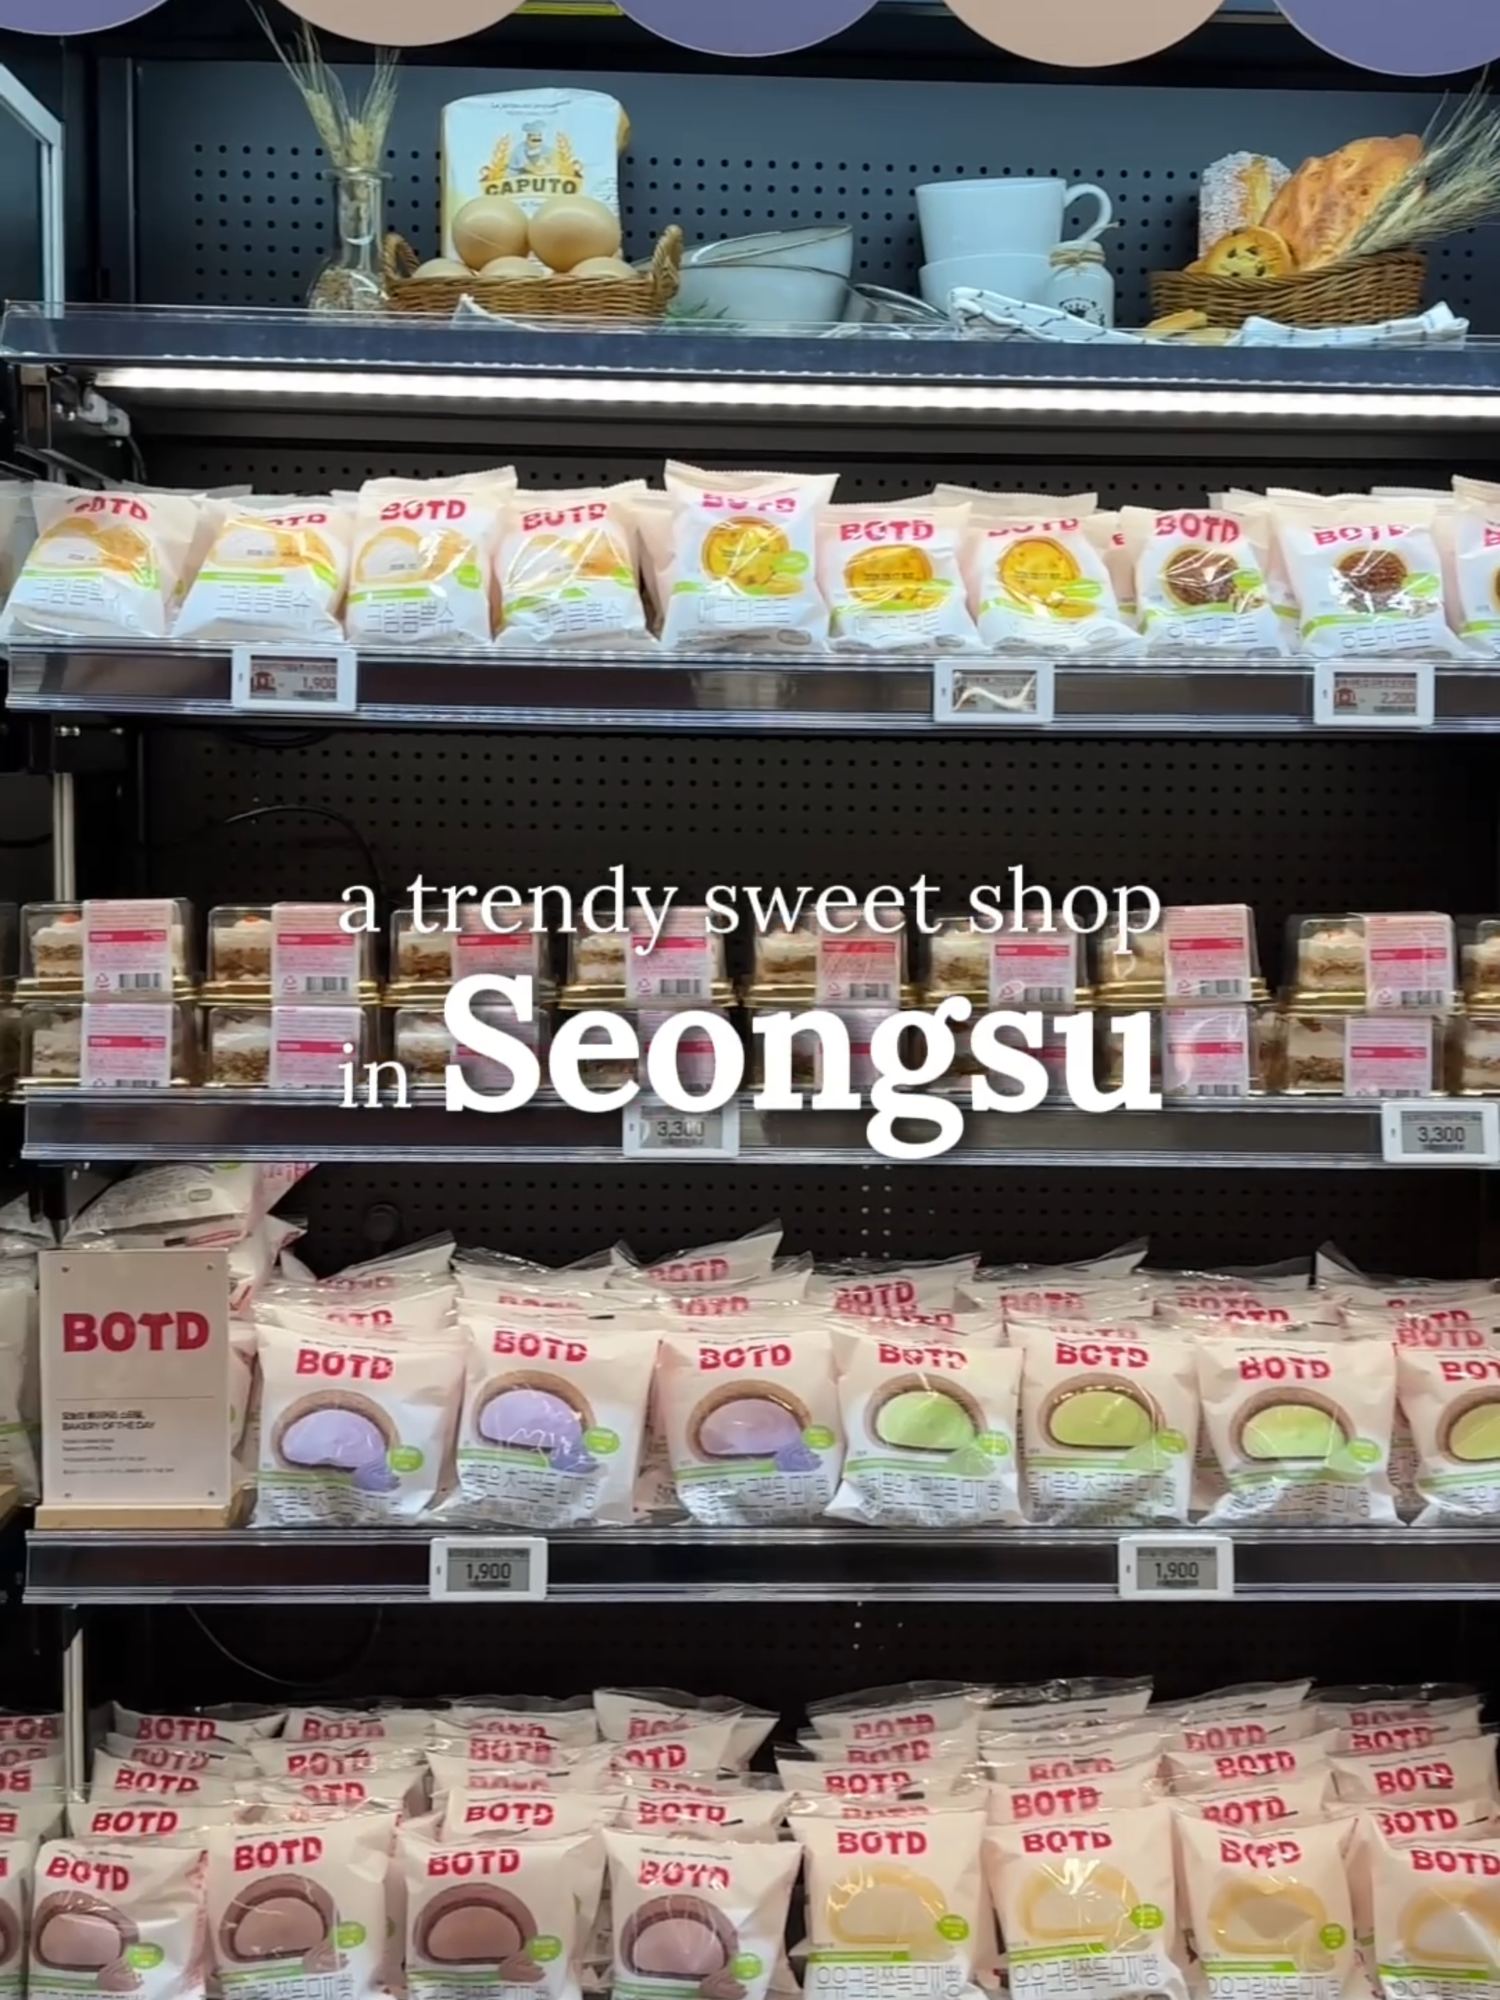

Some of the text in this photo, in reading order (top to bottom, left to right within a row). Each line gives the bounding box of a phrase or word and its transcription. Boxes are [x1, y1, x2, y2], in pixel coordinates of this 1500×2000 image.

[485, 178, 577, 195] CAPUTO
[381, 500, 466, 520] BOTD
[523, 503, 607, 531] BOTD
[840, 520, 934, 541] BOTD
[1155, 514, 1240, 544] BOTD
[302, 676, 337, 690] 1,900
[657, 1121, 705, 1138] 3,300
[1417, 1126, 1466, 1143] 3,300
[64, 1312, 209, 1352] BOTD
[494, 1331, 587, 1363] BOTD
[700, 1345, 791, 1370] BOTD
[879, 1344, 966, 1368] BOTD
[1056, 1343, 1148, 1368] BOTD
[296, 1349, 392, 1380] BOTD
[1240, 1357, 1330, 1380] BOTD
[466, 1563, 512, 1580] 1,900
[1155, 1561, 1200, 1580] 1,900
[137, 1718, 216, 1742] BOTD
[1184, 1724, 1267, 1752] BOTD
[625, 1744, 687, 1769] OTD
[848, 1740, 932, 1767] BOTD
[1216, 1750, 1295, 1780] BOTD
[115, 1769, 199, 1794] BOTD
[826, 1770, 912, 1796] BOTD
[1375, 1763, 1455, 1796] BOTD
[466, 1803, 553, 1826] BOTD
[638, 1801, 727, 1825] BOTD
[1012, 1787, 1101, 1819] BOTD
[1202, 1796, 1287, 1826] BOTD
[92, 1812, 177, 1835] BOTD
[234, 1837, 322, 1871] BOTD
[838, 1832, 927, 1854] BOTD
[1023, 1831, 1112, 1853] BOTD
[46, 1857, 130, 1891] BOTD
[428, 1850, 520, 1876] BOTD
[638, 1861, 730, 1887] BOTD
[1412, 1850, 1500, 1876] BOTD
